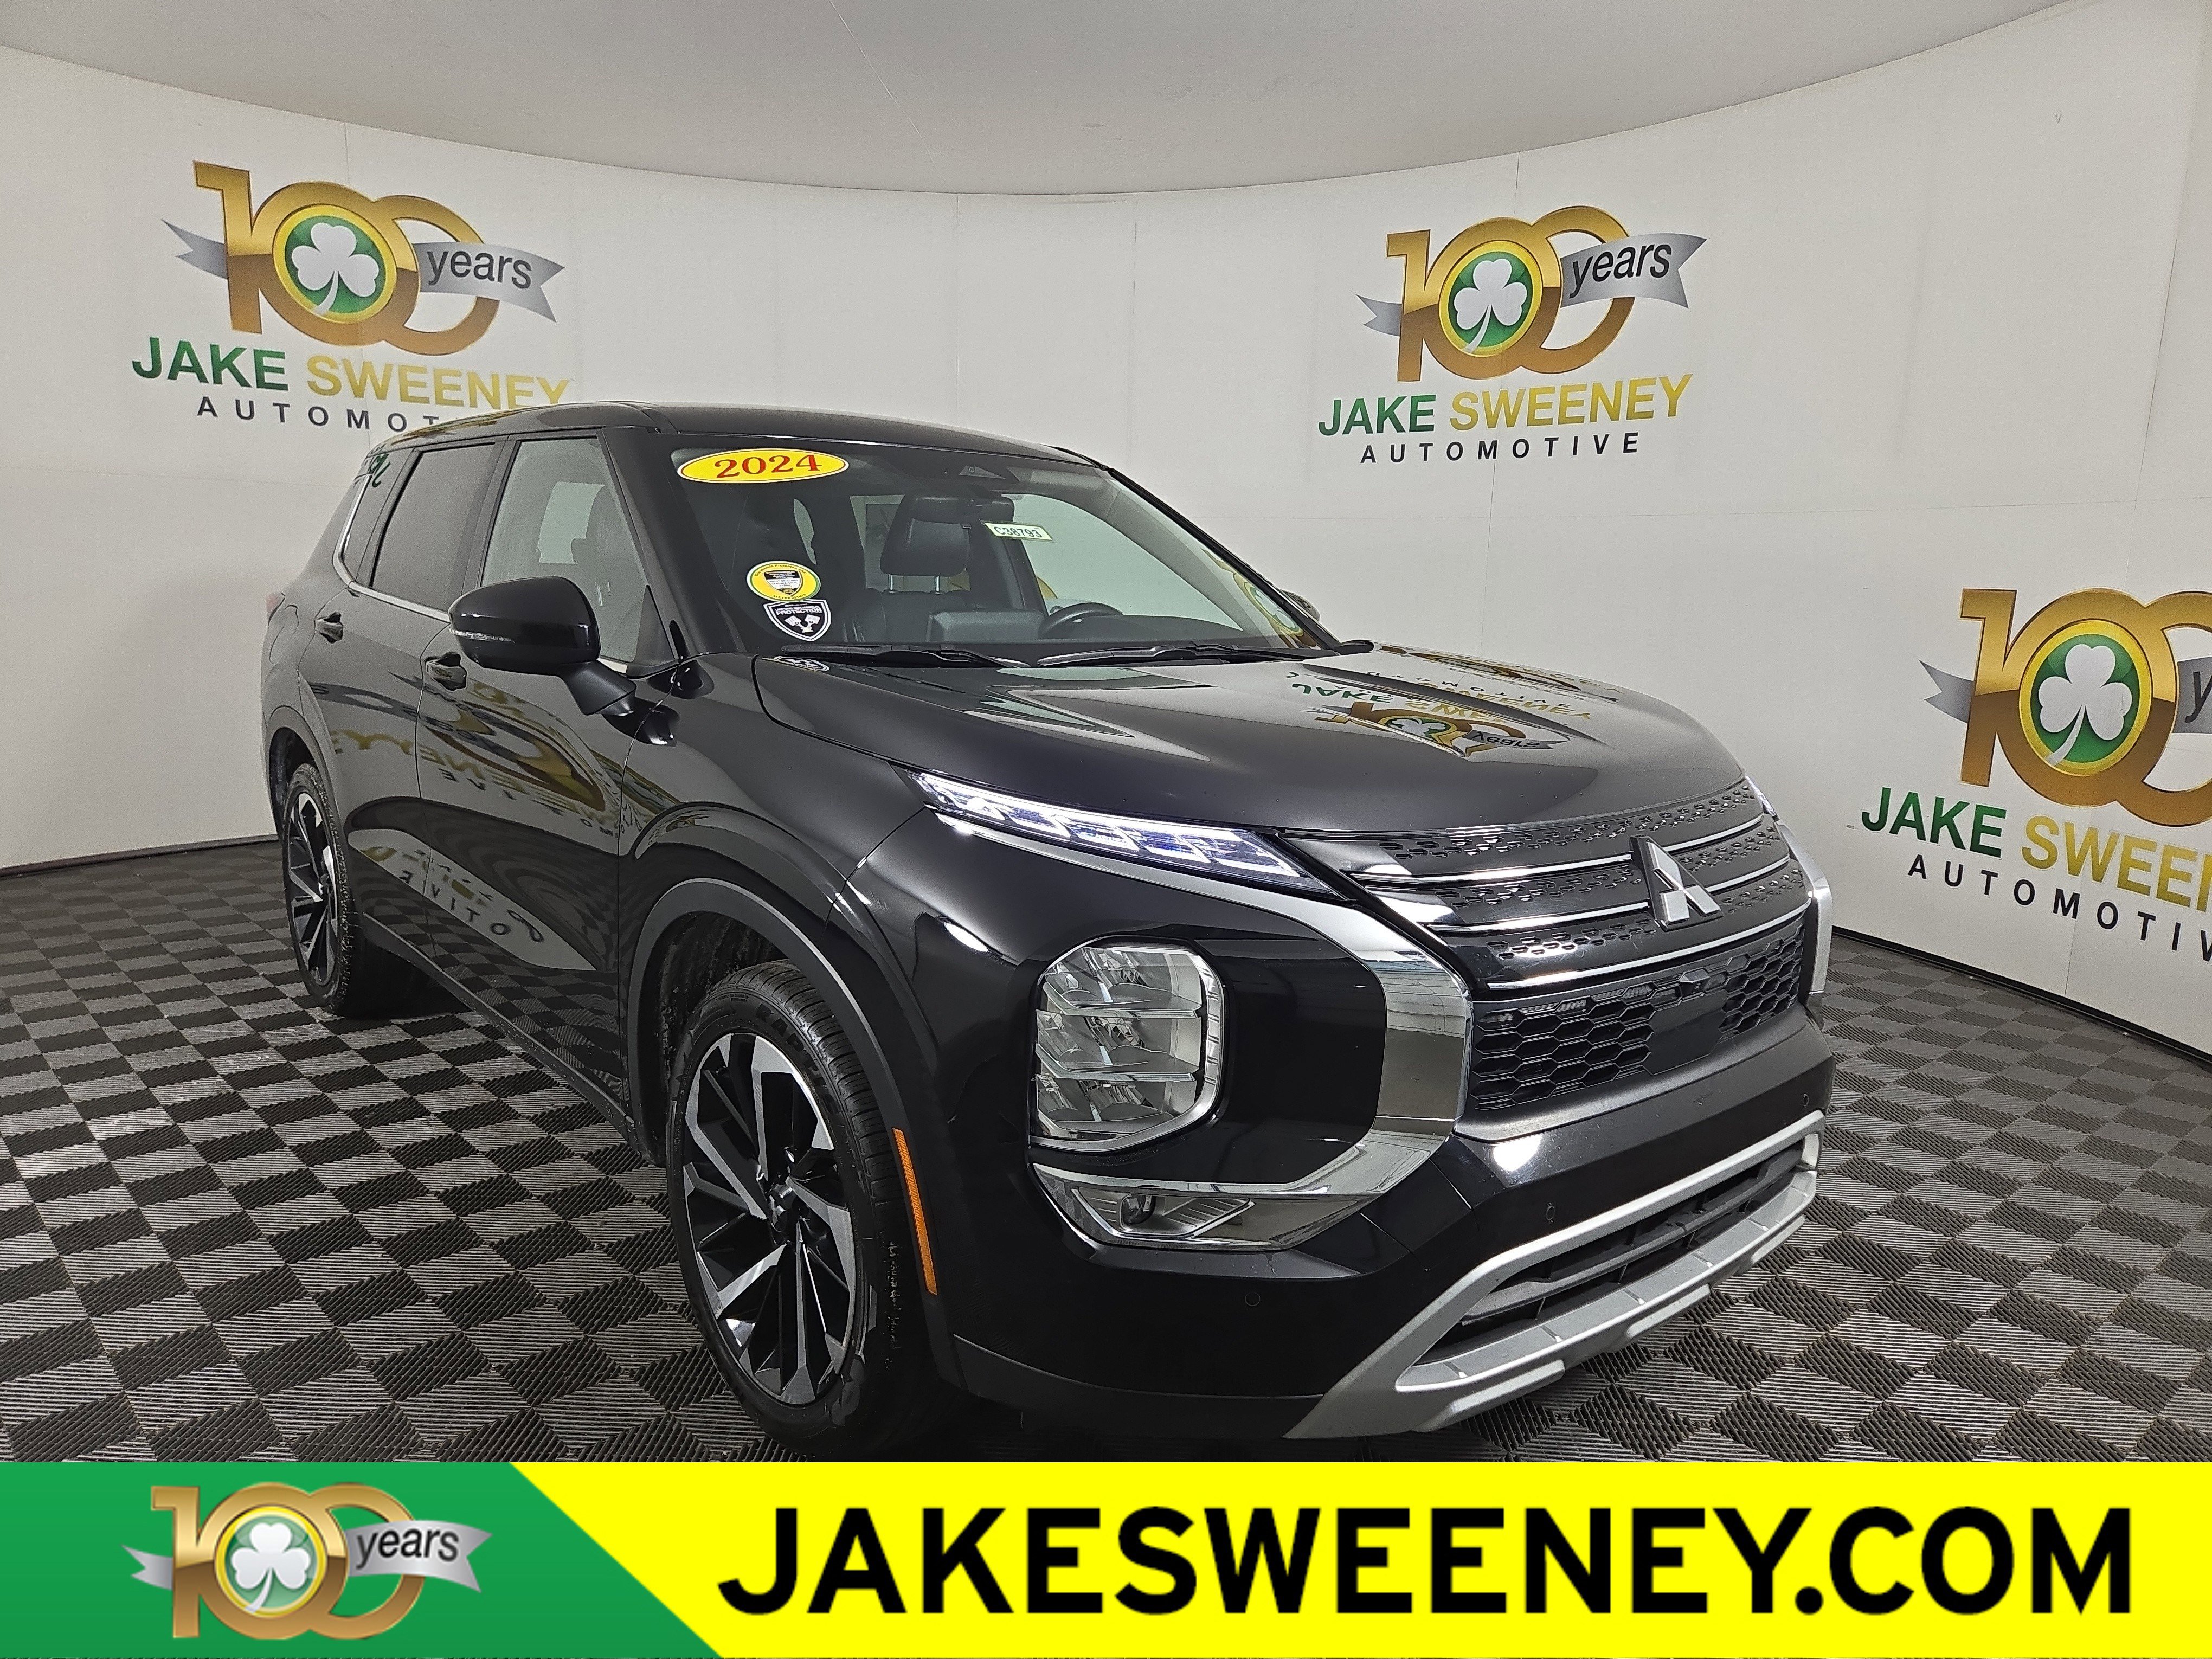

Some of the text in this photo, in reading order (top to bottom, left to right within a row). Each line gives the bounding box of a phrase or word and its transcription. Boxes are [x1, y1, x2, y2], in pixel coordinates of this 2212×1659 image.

[193, 160, 500, 355] 100
[427, 250, 532, 290] years
[1569, 242, 1673, 299] years
[1386, 205, 1635, 382] 100
[132, 337, 570, 410] JAKE SWEENEY
[197, 396, 439, 432] AUTOMOT
[1319, 374, 1693, 436] JAKE SWEENEY
[713, 454, 822, 478] 2024
[1360, 432, 1639, 464] AUTOMOTIVE
[993, 526, 1043, 538] C38793
[1862, 787, 2007, 858] JAKE
